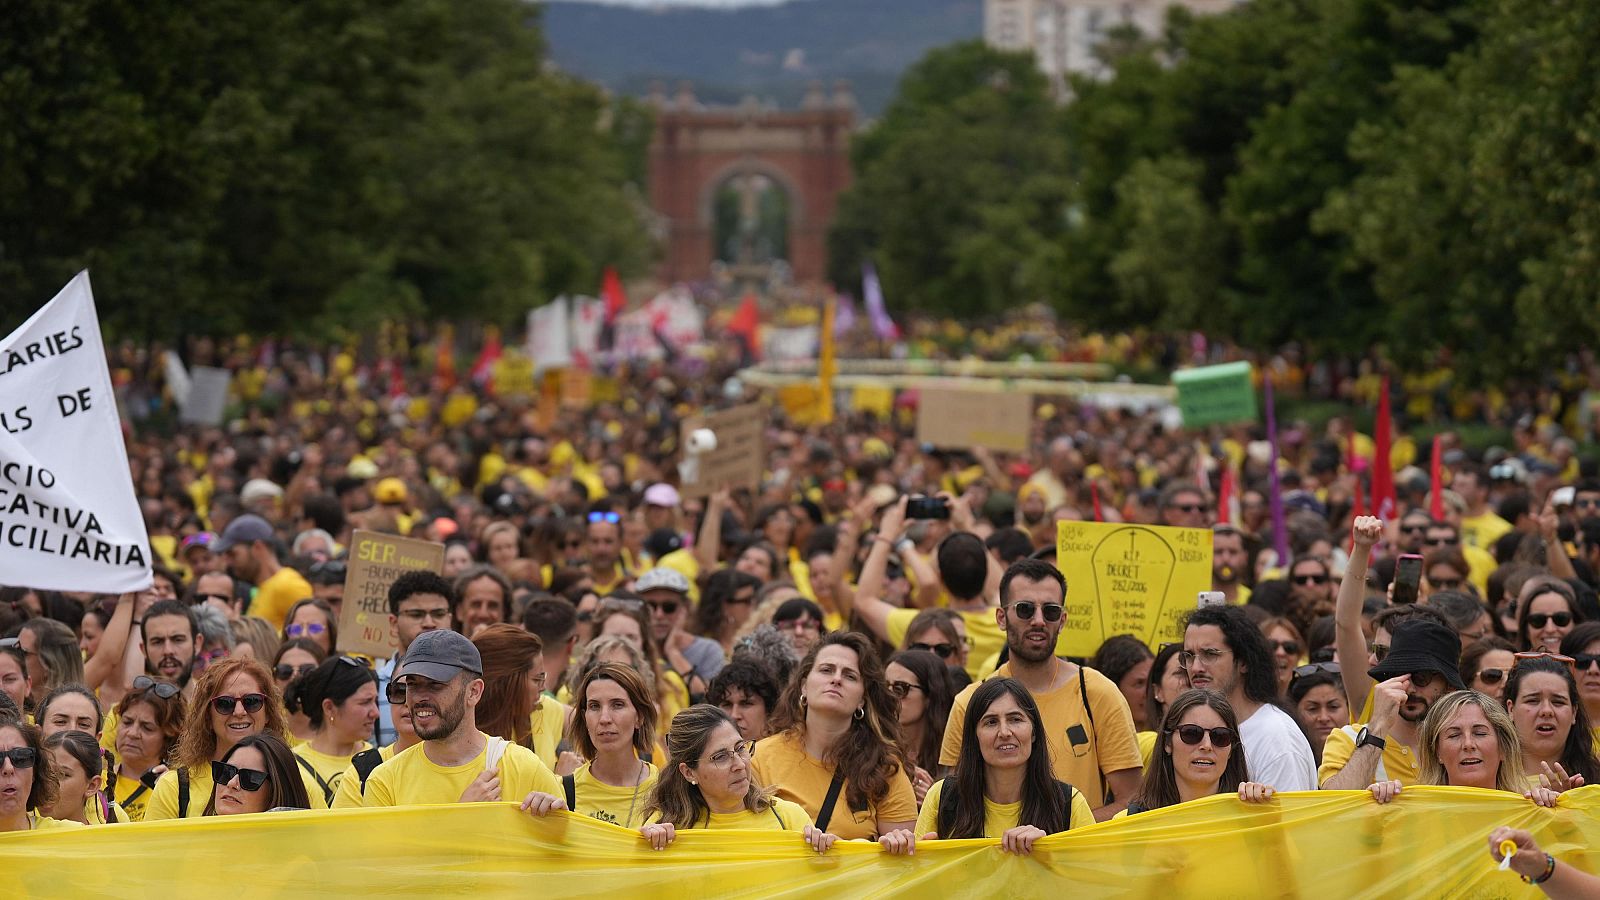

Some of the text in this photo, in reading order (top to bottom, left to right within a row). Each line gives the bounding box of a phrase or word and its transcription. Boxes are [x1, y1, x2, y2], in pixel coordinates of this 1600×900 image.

[57, 387, 91, 417] DE
[0, 461, 55, 489] CIO
[358, 540, 397, 564] SER
[1106, 563, 1140, 579] DECRET
